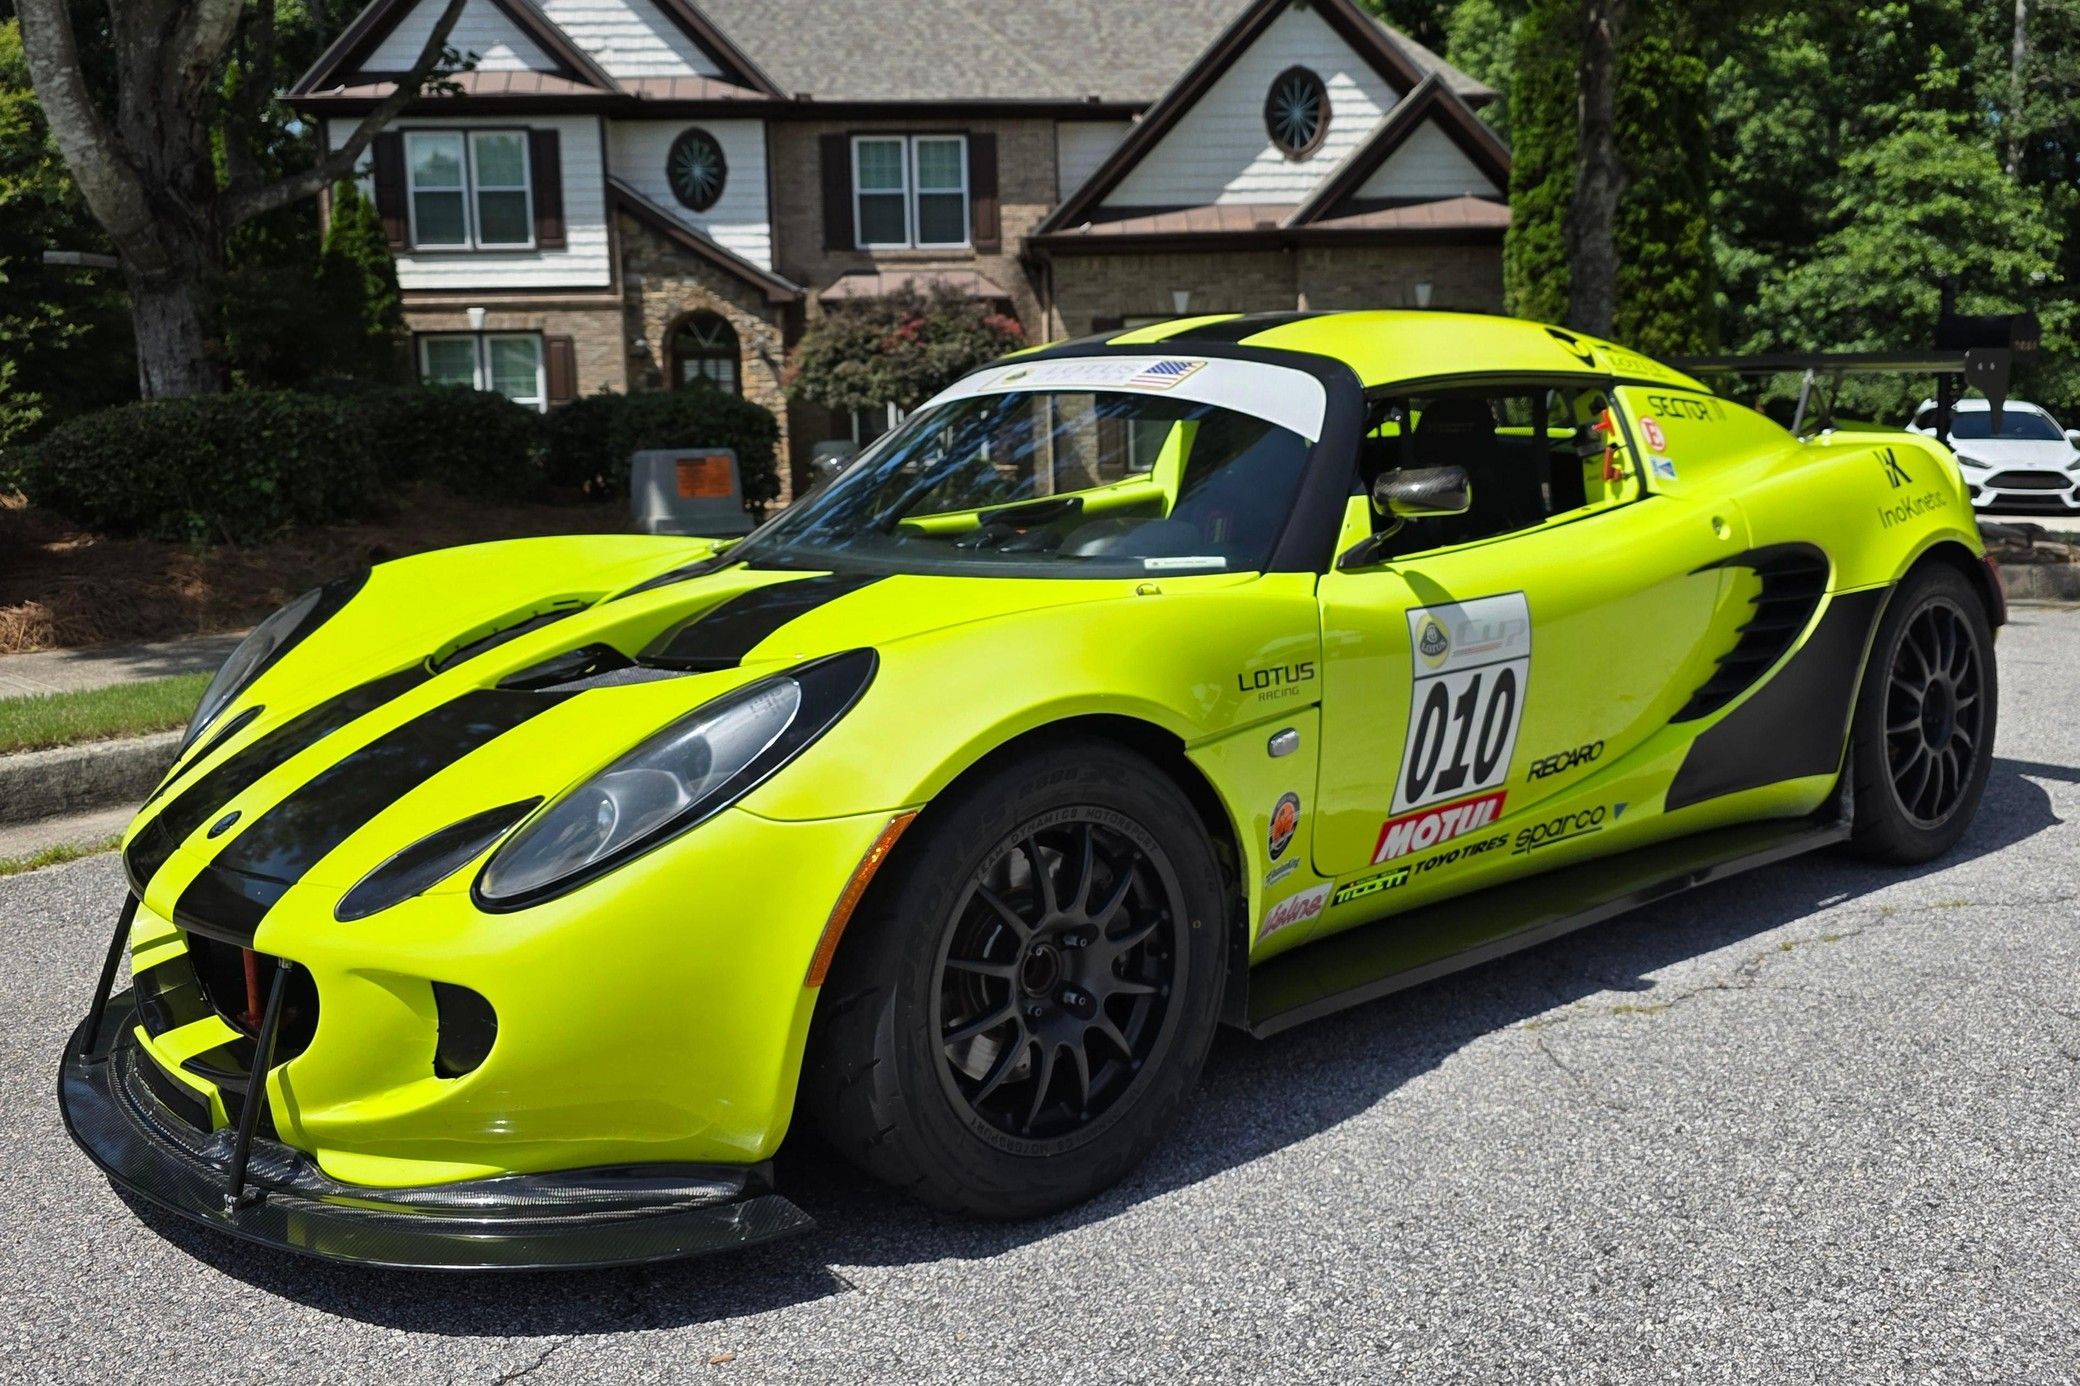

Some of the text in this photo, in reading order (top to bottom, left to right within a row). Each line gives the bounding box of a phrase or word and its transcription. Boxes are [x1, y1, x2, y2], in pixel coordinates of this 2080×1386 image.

[1237, 661, 1315, 692] LOTUS
[1258, 686, 1300, 701] RACING
[1405, 667, 1516, 805] 010
[1526, 740, 1604, 783] RECARO
[1010, 807, 1078, 843] DYNAMICS
[1085, 808, 1160, 853] MOTORSPORT
[1374, 798, 1498, 864] MOTUL
[1514, 805, 1607, 855] sparco
[1415, 832, 1510, 876] TOYO TIRES
